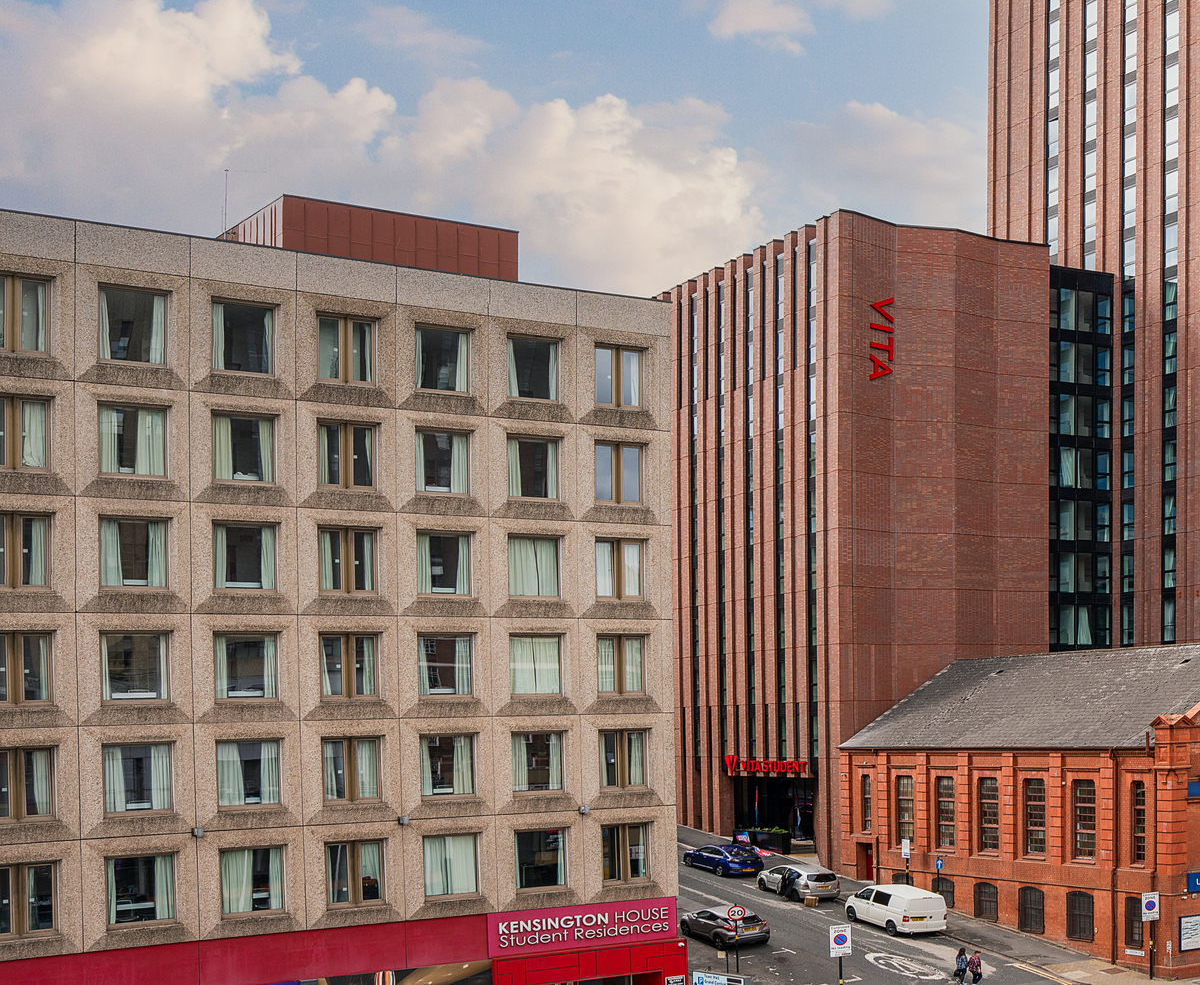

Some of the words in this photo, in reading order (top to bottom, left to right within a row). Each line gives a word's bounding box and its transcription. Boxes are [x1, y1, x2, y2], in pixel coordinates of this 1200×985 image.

[869, 297, 895, 381] VITA
[740, 760, 762, 772] VITA
[762, 760, 807, 773] STUDENT
[498, 913, 609, 935] KENSINGTON
[614, 907, 669, 923] HOUSE
[499, 929, 569, 948] Student
[574, 921, 670, 940] Residences
